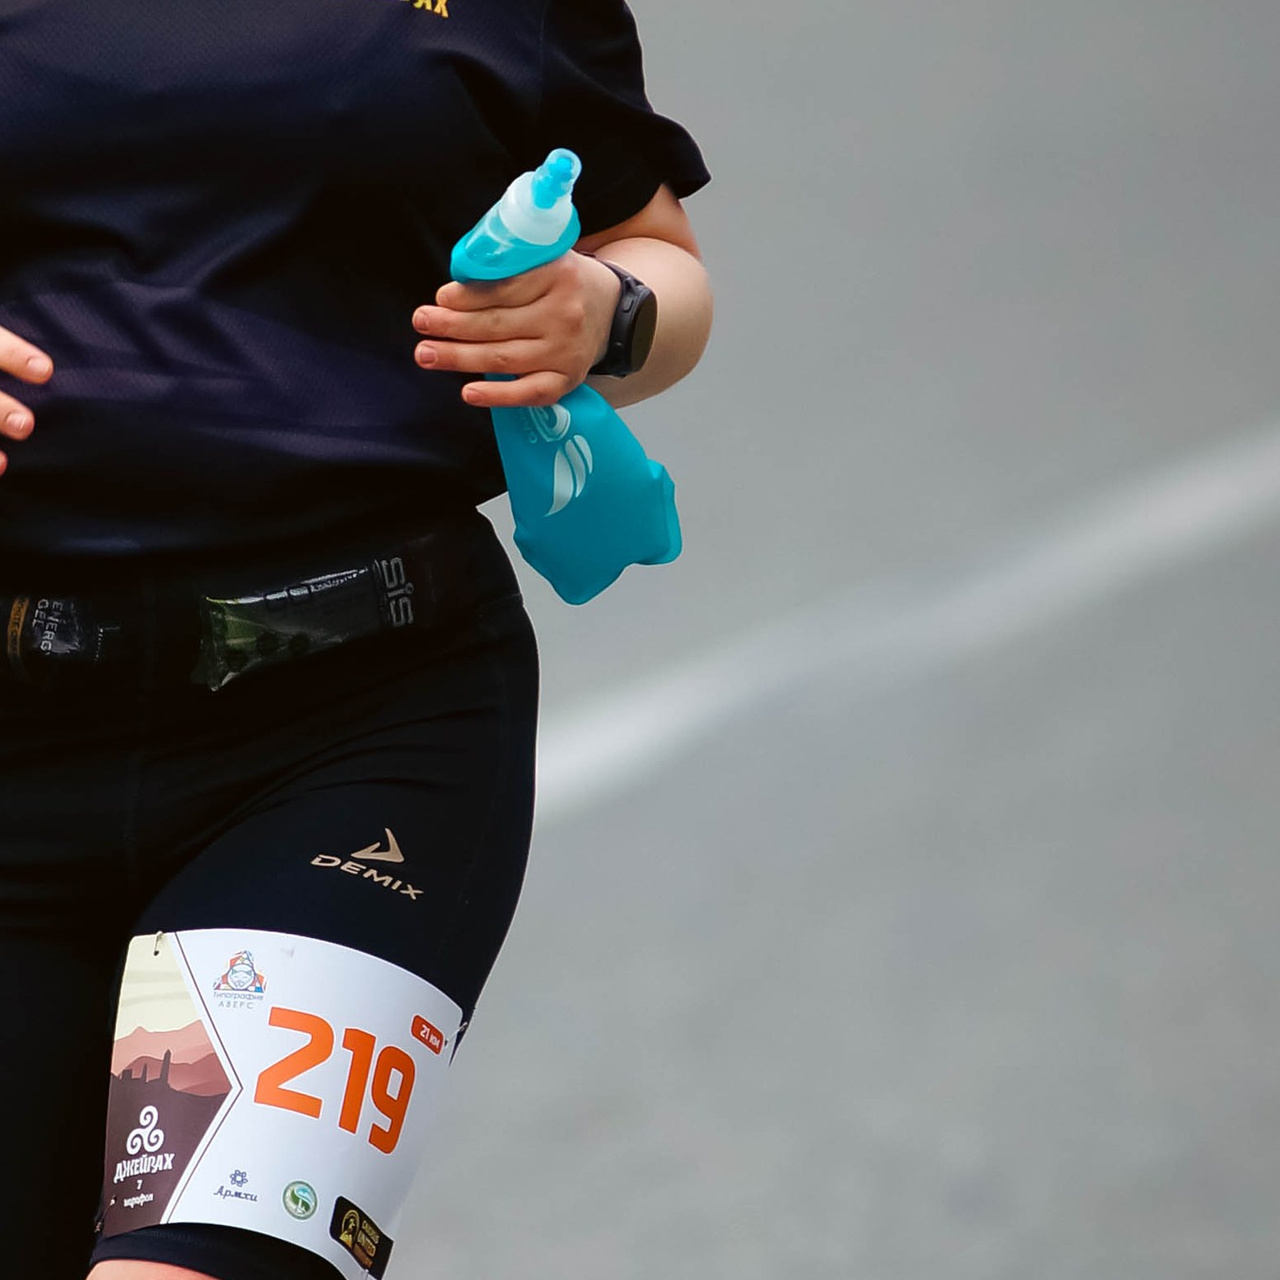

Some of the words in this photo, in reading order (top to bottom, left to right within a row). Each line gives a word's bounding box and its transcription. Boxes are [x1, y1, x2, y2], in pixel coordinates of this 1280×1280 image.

[39, 599, 64, 657] ENERG
[310, 854, 424, 900] DEMIX
[419, 1023, 431, 1041] 21
[254, 1006, 416, 1155] 219
[113, 1153, 175, 1184] ДЖЕЙРАХ
[213, 1185, 258, 1202] Армхи
